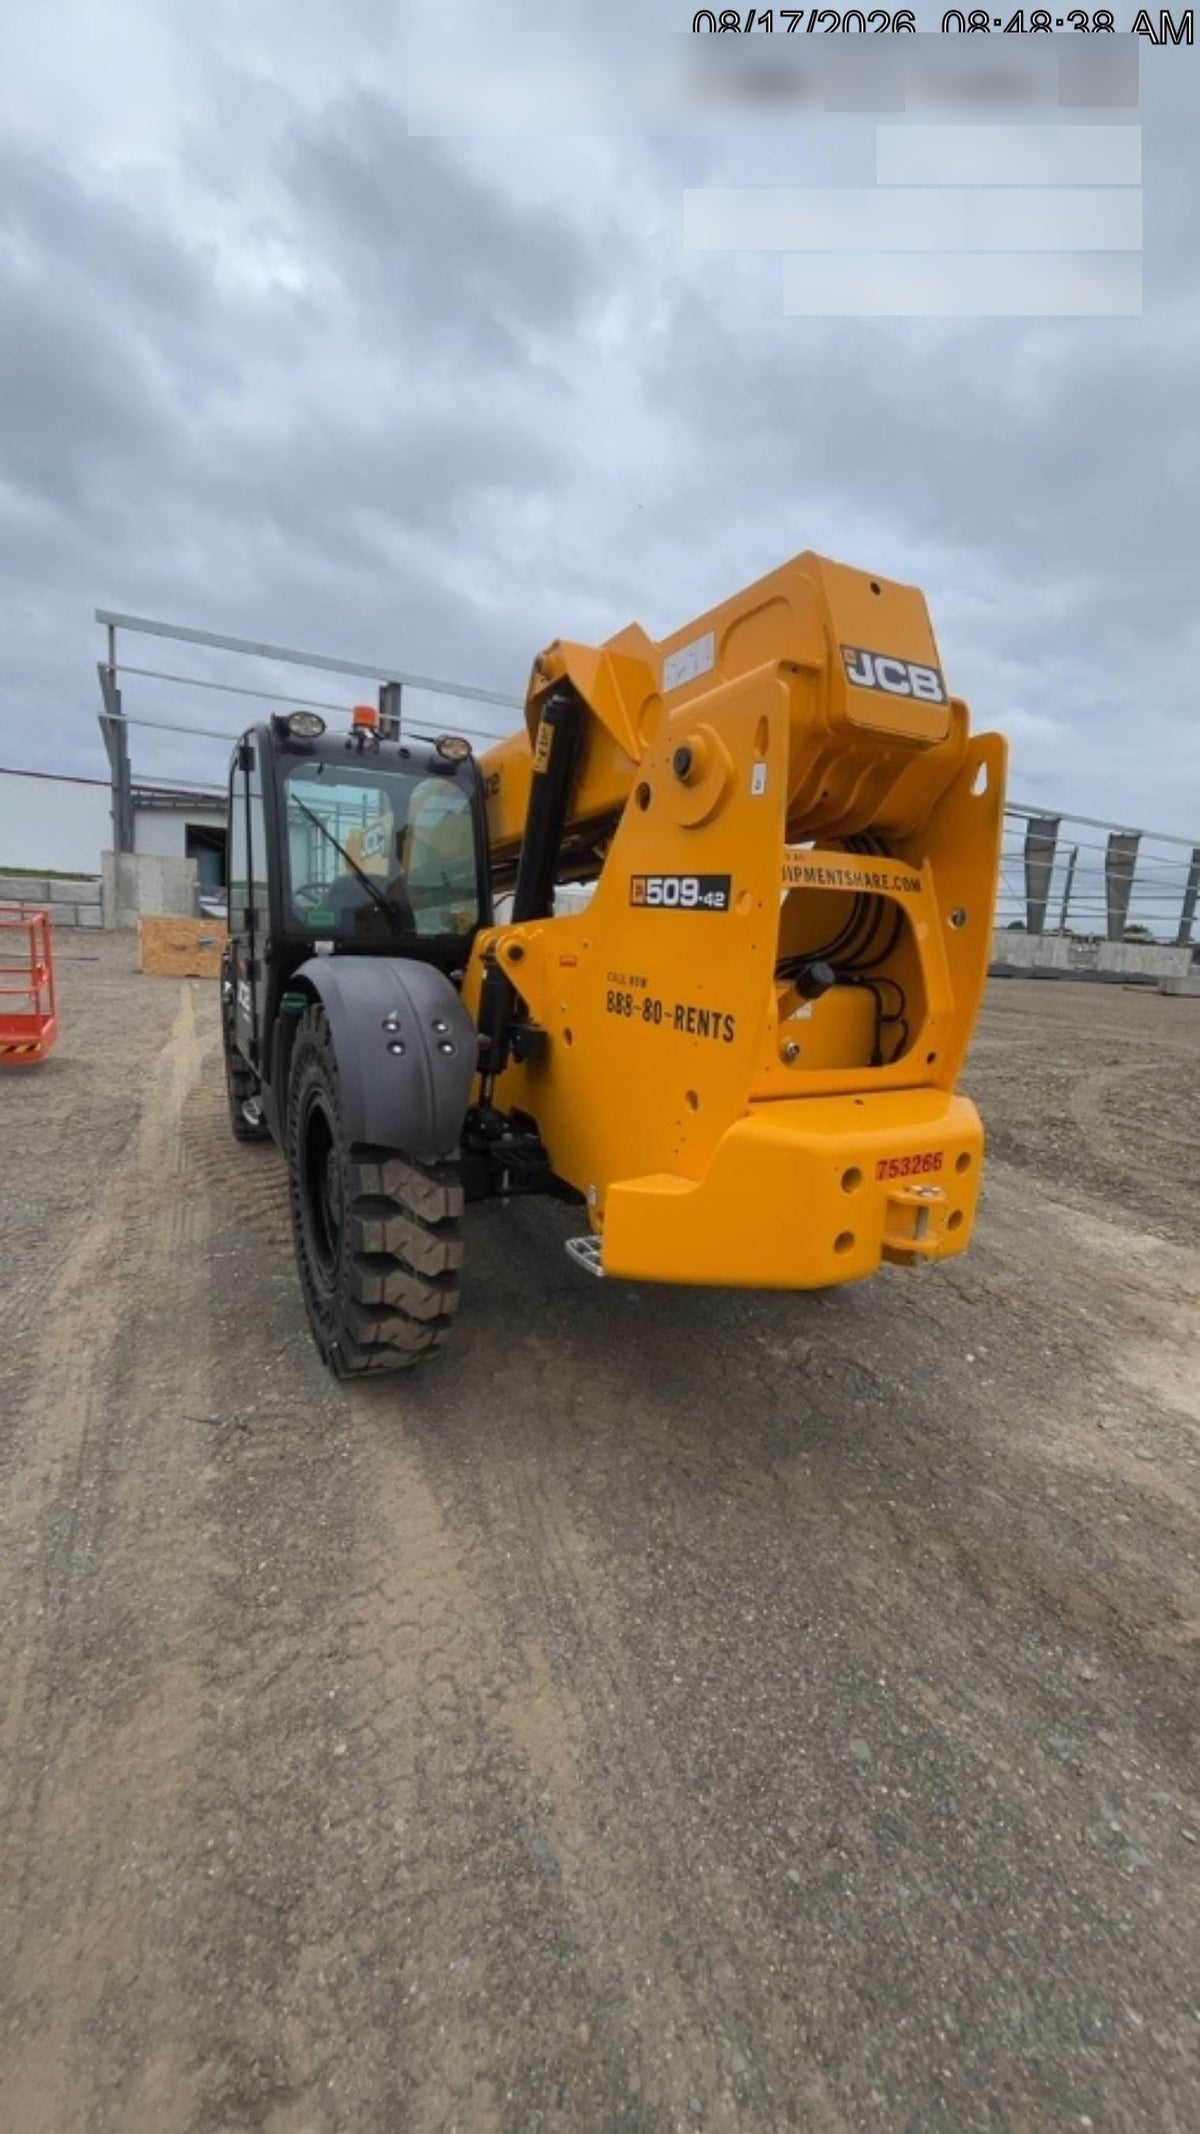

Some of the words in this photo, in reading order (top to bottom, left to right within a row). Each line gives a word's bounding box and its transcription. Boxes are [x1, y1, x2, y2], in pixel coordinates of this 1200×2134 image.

[847, 651, 943, 703] JCB
[606, 990, 736, 1043] 888-80-RENTS
[876, 1151, 944, 1182] 753266
